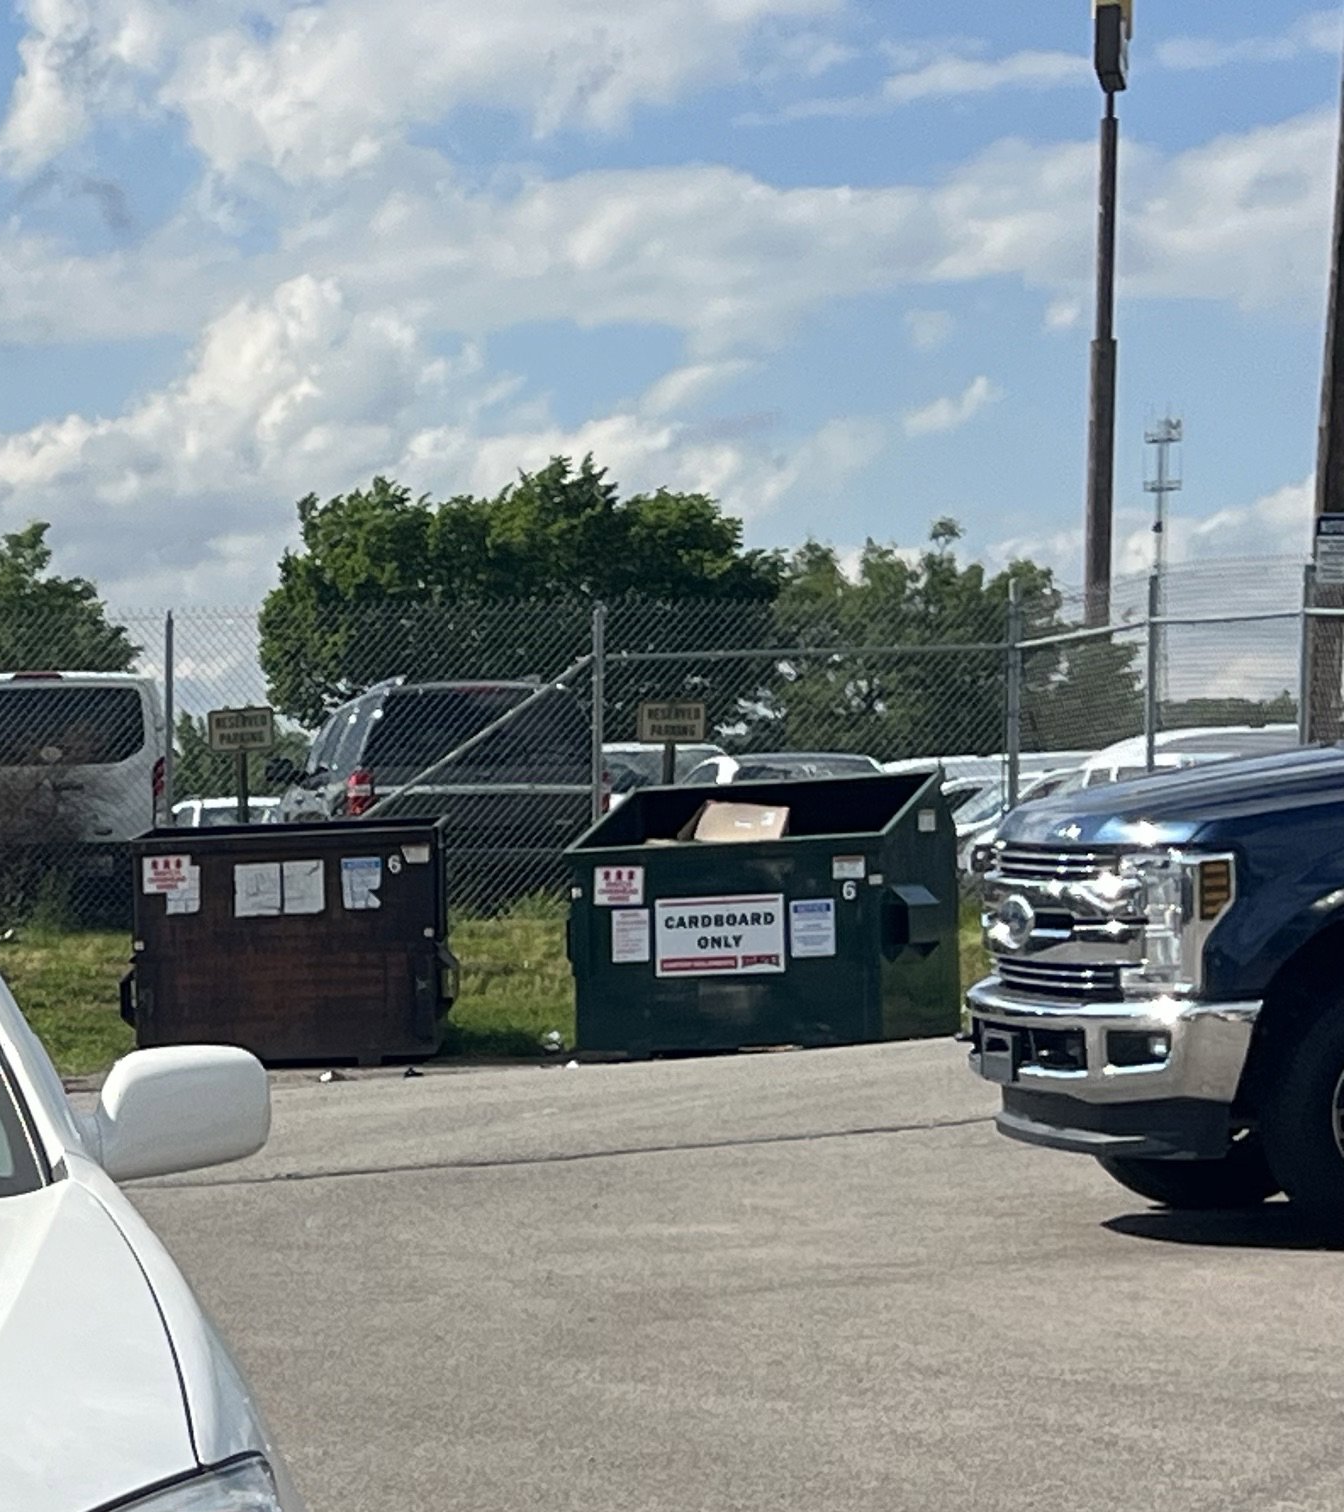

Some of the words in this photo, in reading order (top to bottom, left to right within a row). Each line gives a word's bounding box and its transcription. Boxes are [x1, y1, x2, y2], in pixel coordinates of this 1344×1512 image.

[215, 713, 268, 729] RESERVED
[647, 707, 701, 720] RESERVED
[219, 731, 266, 745] PARKING
[651, 724, 697, 737] PARKING
[388, 855, 402, 874] 6
[842, 880, 857, 900] 6
[664, 911, 775, 930] CARDBOARD
[696, 934, 743, 950] ONLY
